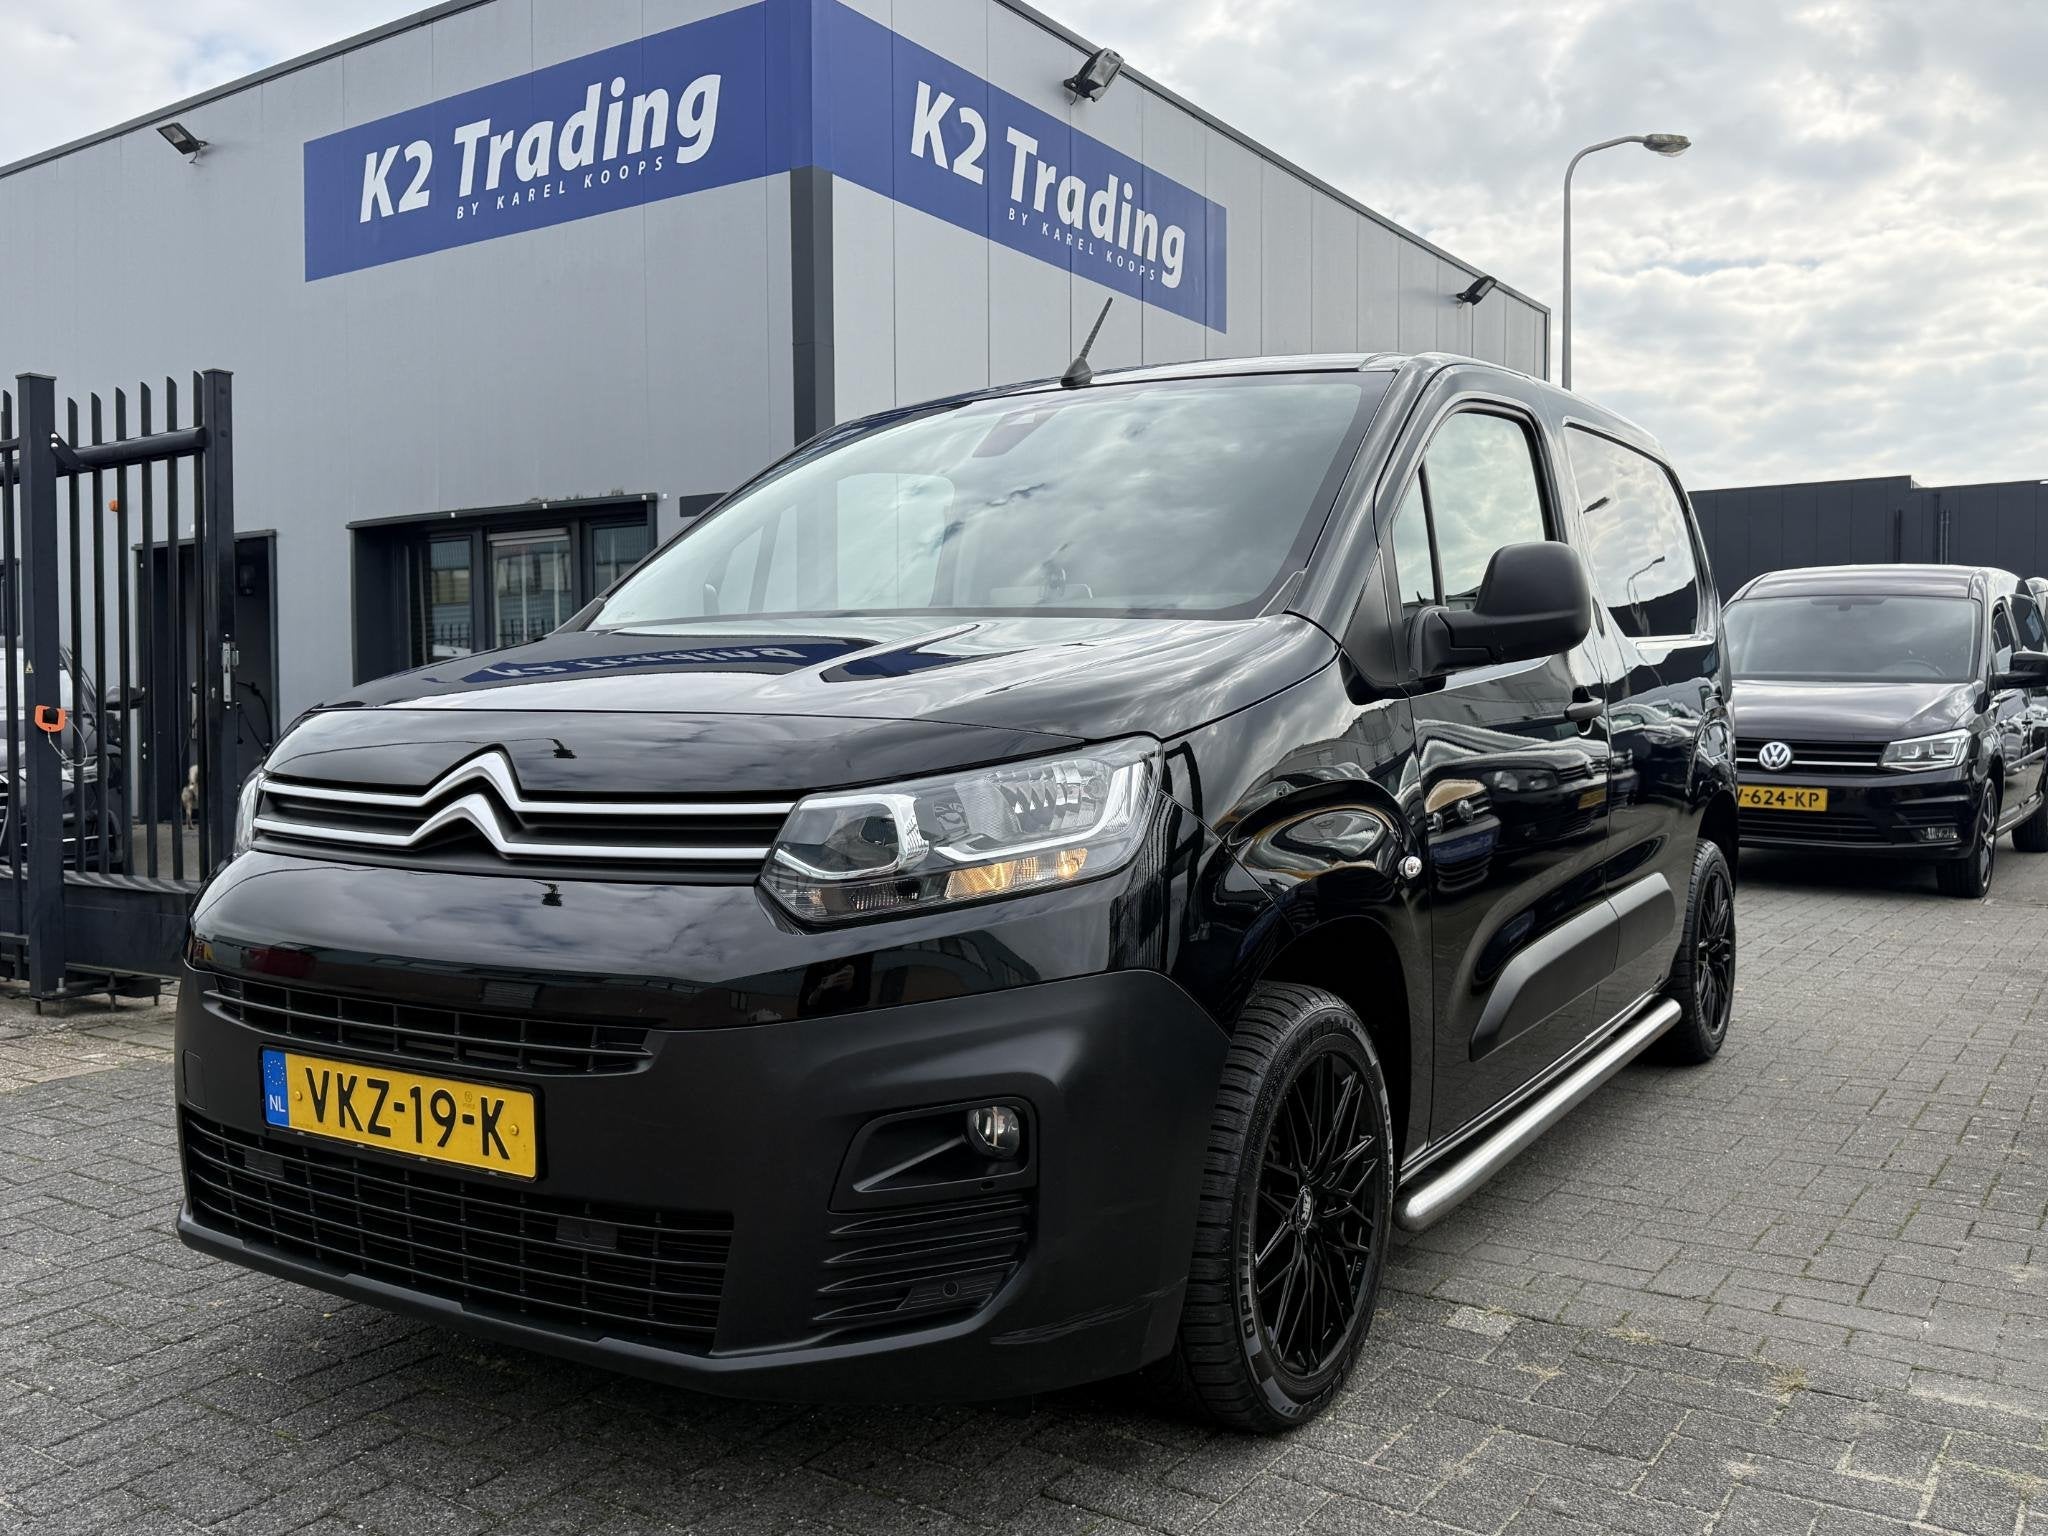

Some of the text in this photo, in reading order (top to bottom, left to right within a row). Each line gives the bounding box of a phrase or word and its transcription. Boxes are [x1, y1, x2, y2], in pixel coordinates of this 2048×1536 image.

[360, 74, 722, 223] K2 Trading
[456, 156, 663, 219] BY KAREL KOOPS
[910, 81, 1186, 289] K2 Trading
[1008, 208, 1156, 281] BY KAREL KOOPS
[269, 1093, 287, 1114] NL
[305, 1067, 511, 1160] VKZ-19-K
